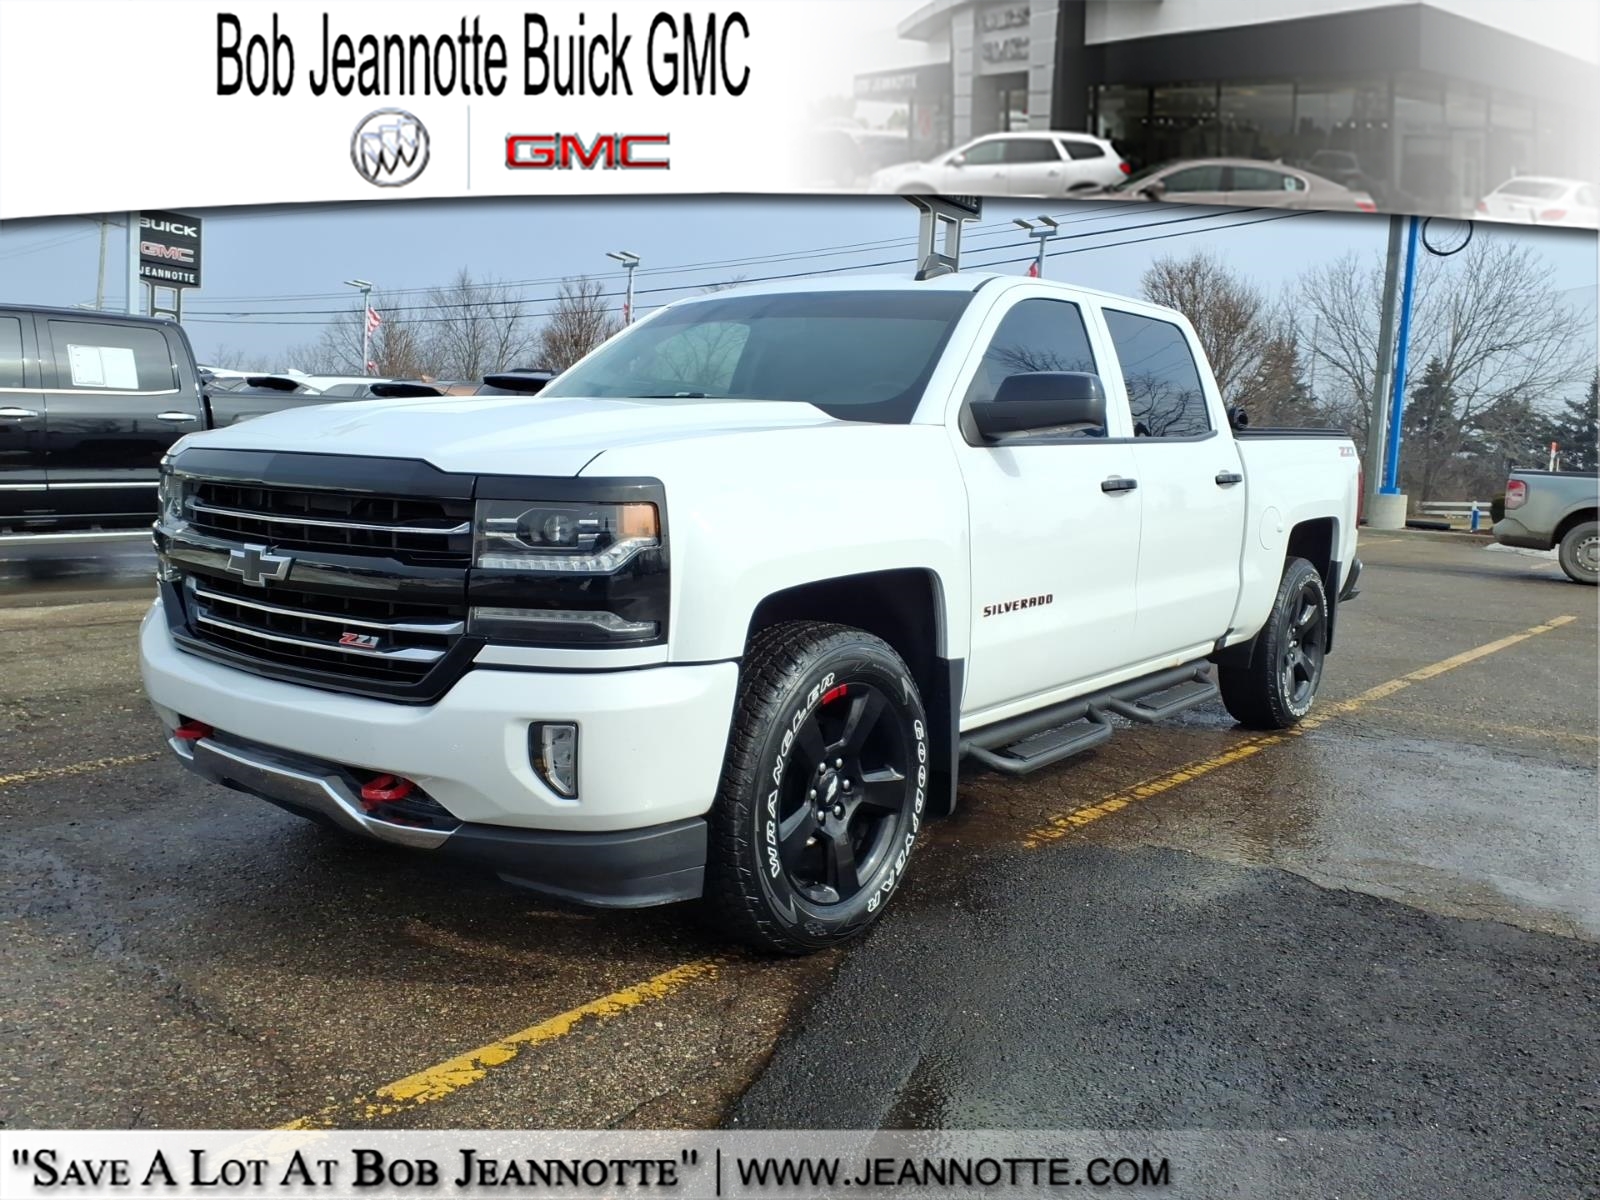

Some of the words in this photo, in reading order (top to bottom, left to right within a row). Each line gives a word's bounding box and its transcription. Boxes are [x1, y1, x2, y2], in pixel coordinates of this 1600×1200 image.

[140, 241, 194, 263] GMC
[140, 266, 195, 283] JEANNOTTE
[983, 593, 1053, 617] SILVERADO
[339, 632, 379, 649] Z71
[766, 672, 835, 879] WRANGLER
[867, 719, 926, 912] GOODYEAR
